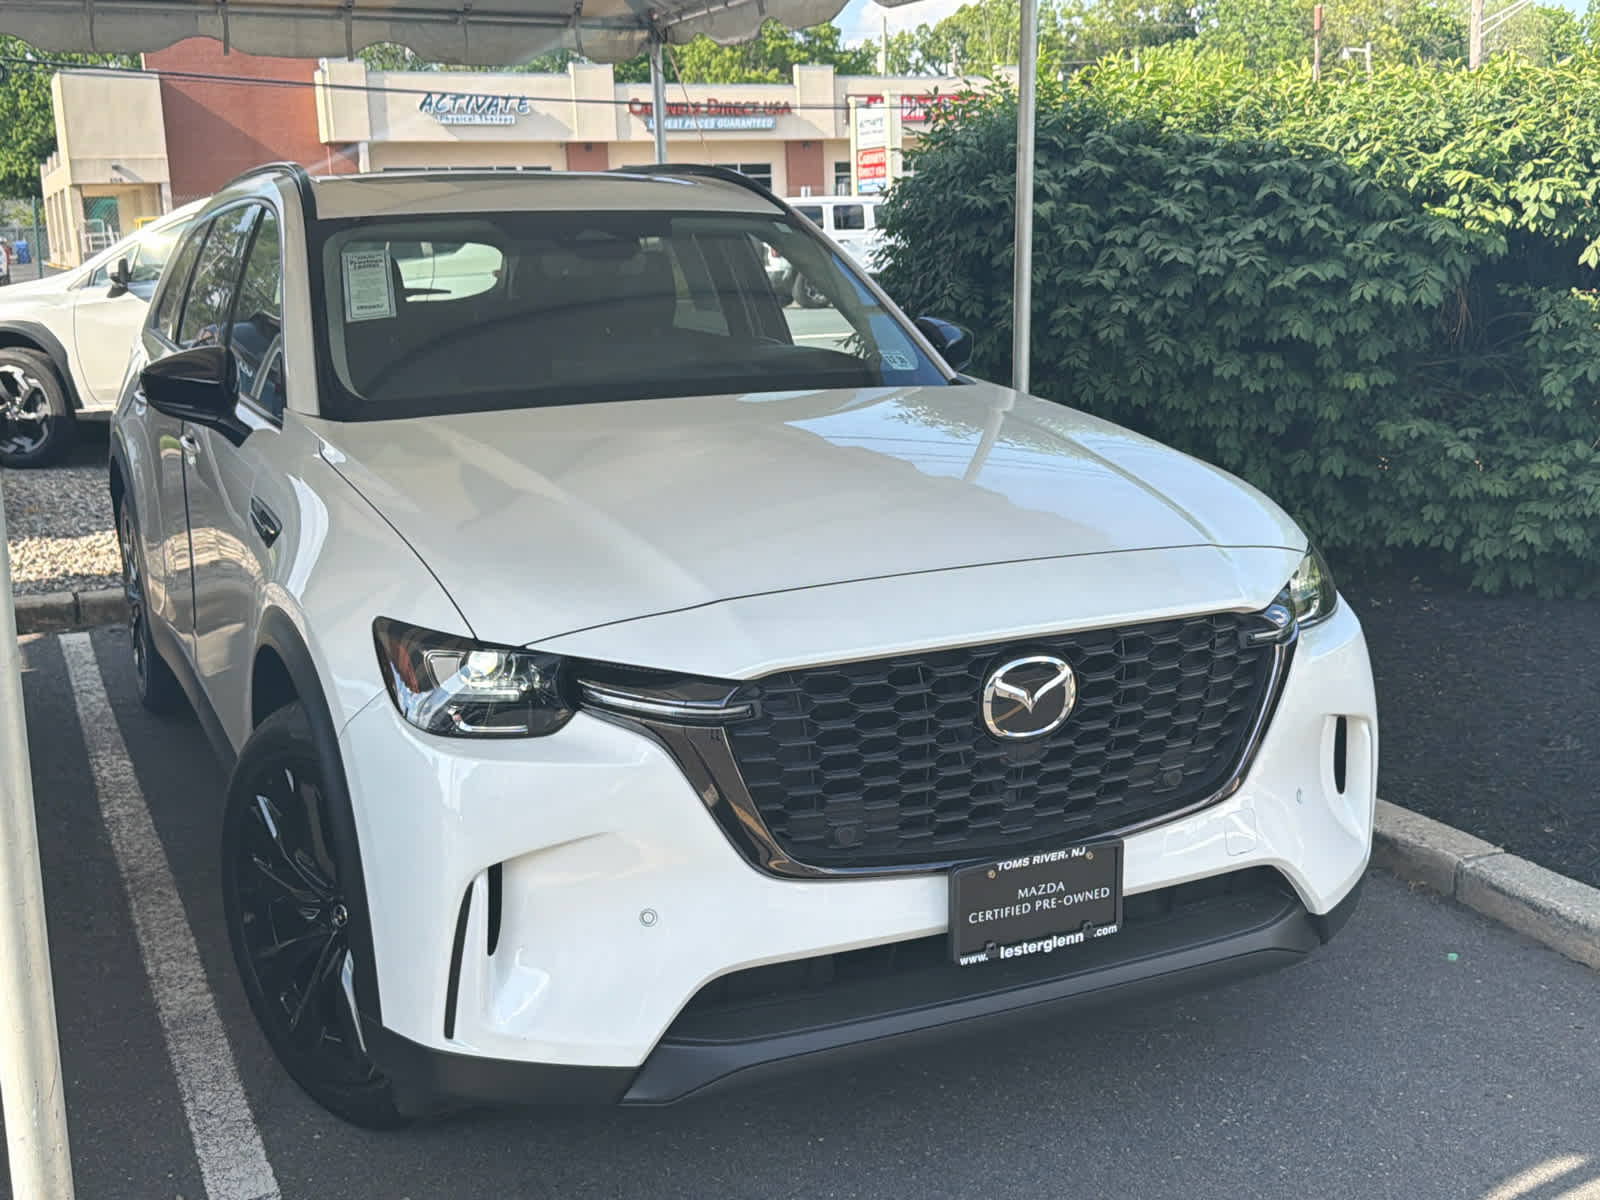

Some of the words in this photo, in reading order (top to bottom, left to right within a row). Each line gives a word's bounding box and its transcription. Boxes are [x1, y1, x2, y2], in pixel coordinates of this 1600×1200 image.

[418, 93, 530, 115] ACTIVATE
[629, 98, 701, 116] CANETS
[707, 98, 760, 116] DIRECT
[763, 101, 792, 116] USA
[717, 117, 774, 129] GUARANTEED
[997, 857, 1030, 872] TOMS
[1071, 846, 1086, 858] NJ
[1017, 880, 1066, 899] MAZDA
[968, 902, 1032, 924] CERTIFIED
[1035, 887, 1110, 911] PRE-OWNED
[1000, 931, 1085, 959] lesterglenn
